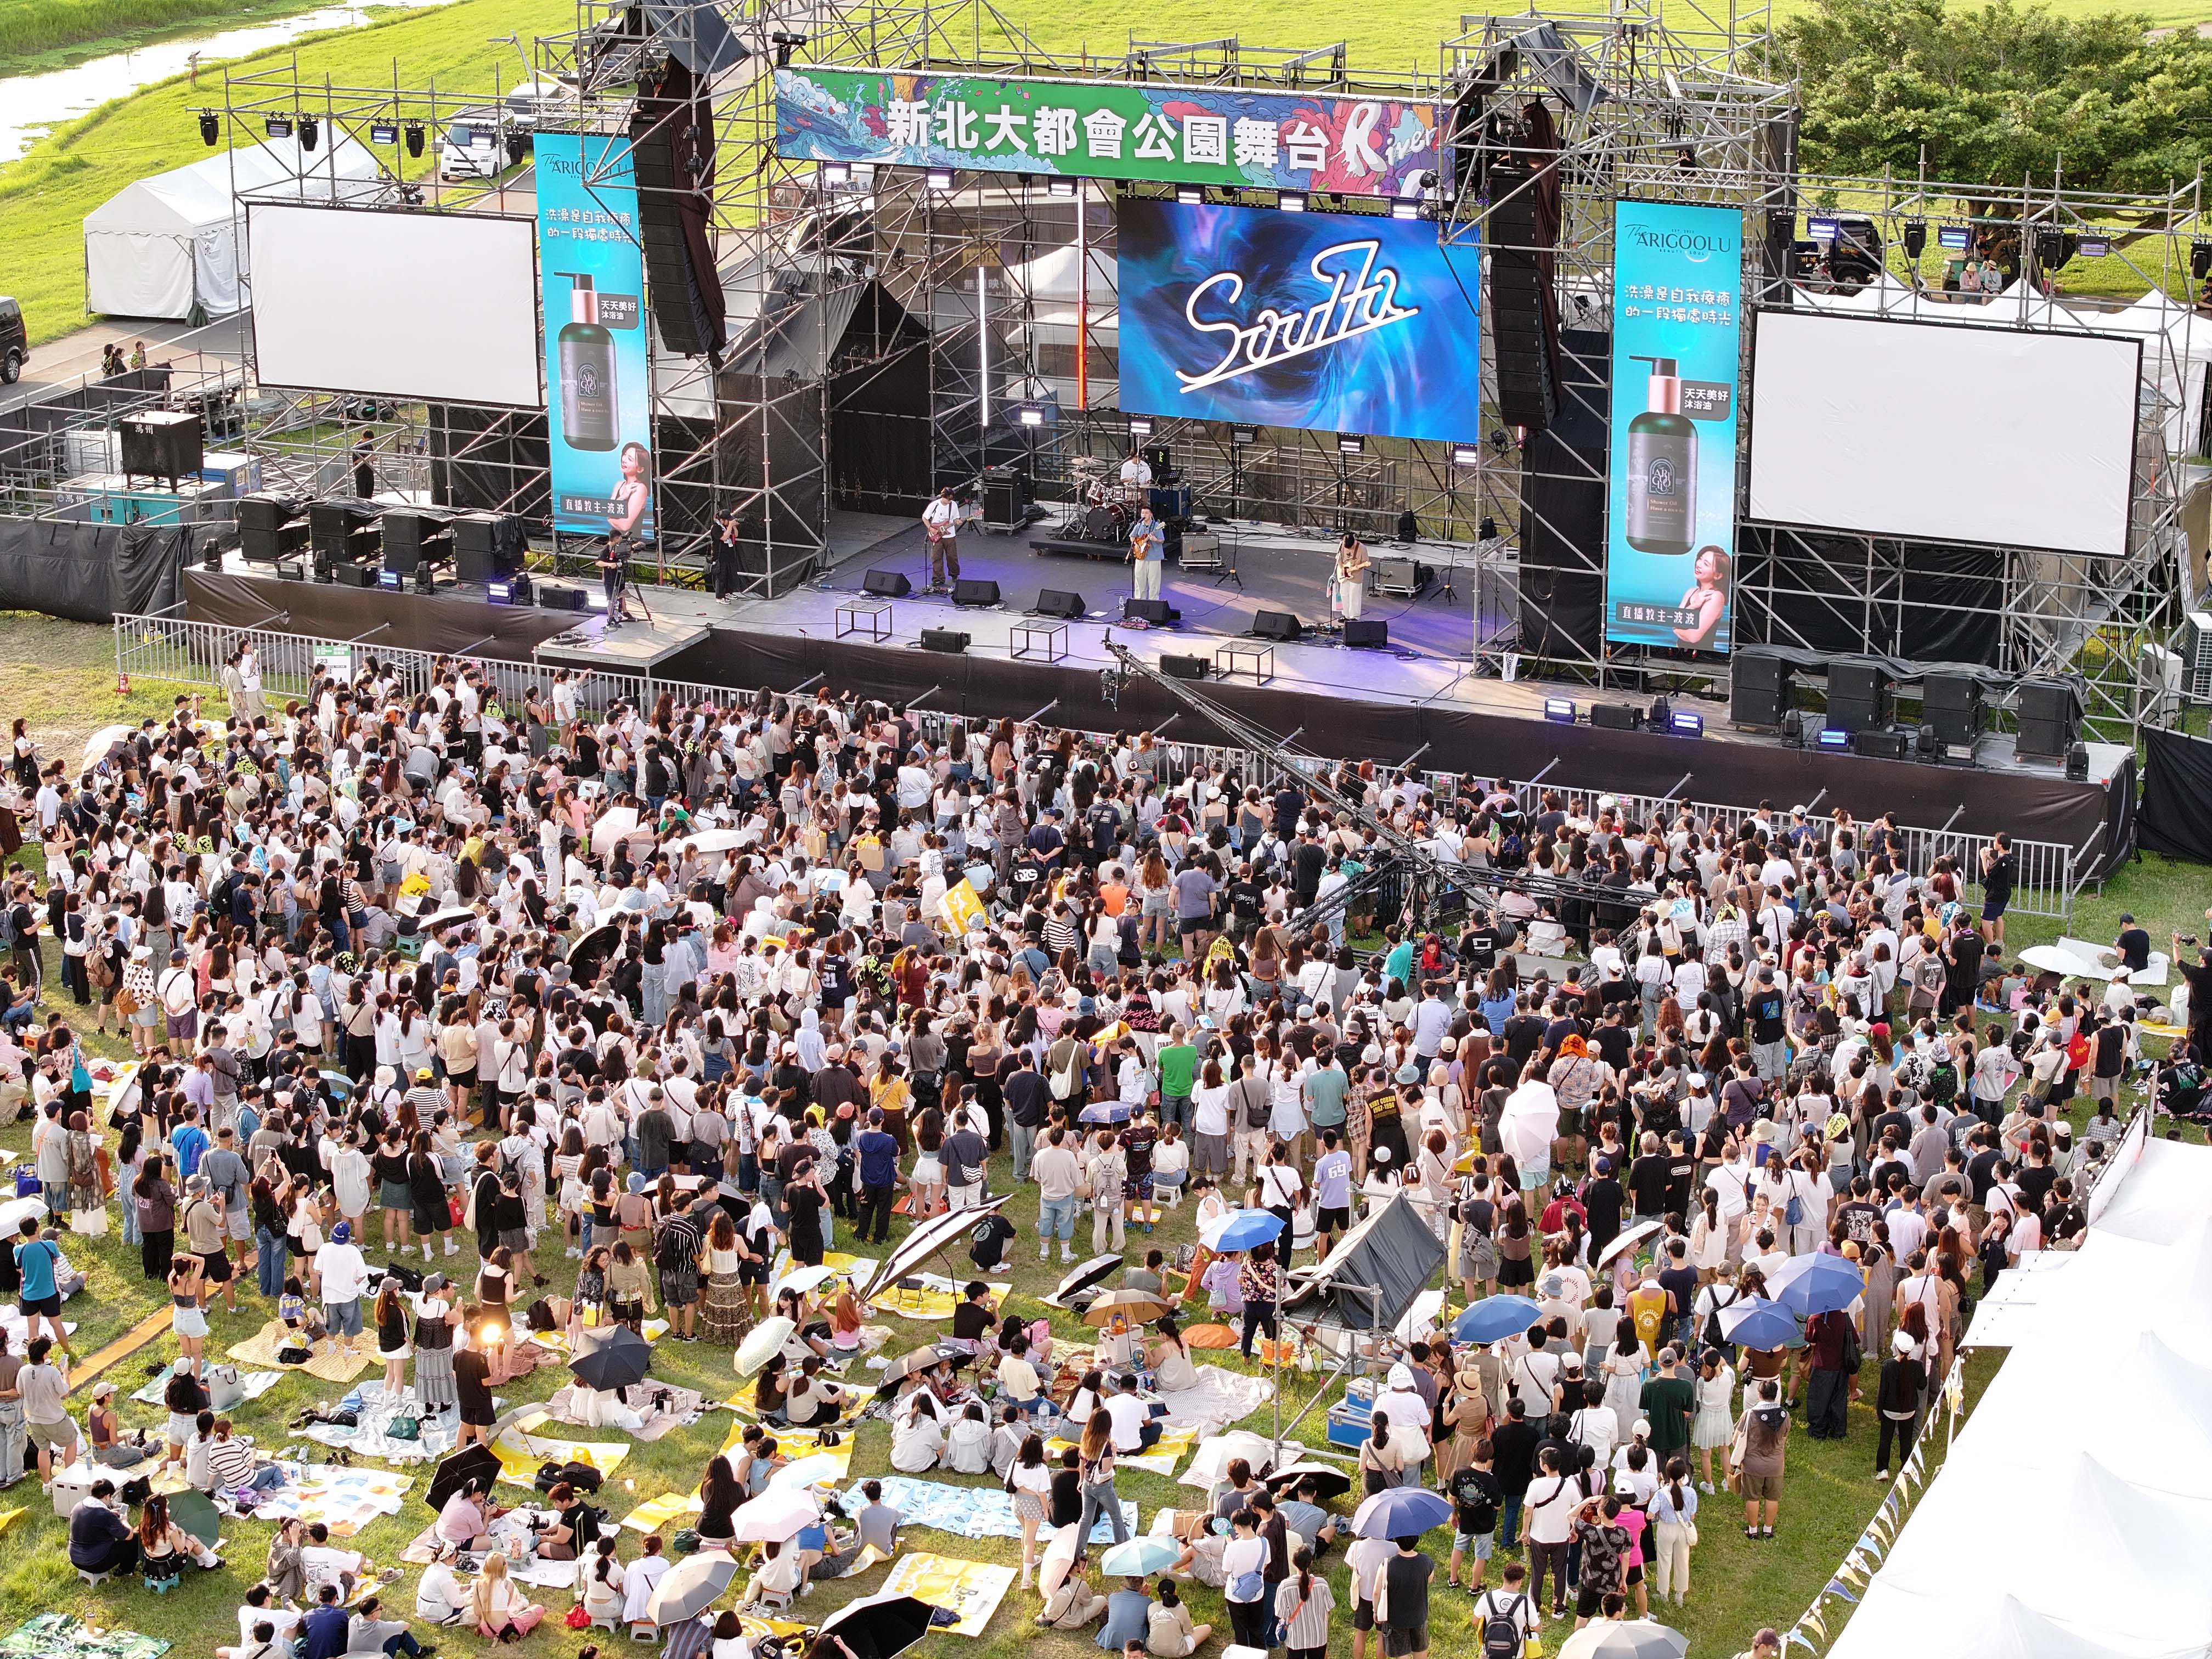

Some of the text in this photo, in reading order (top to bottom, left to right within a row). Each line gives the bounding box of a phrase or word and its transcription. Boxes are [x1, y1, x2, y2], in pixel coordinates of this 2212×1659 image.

[887, 98, 1331, 171] 新北大都會公園舞台
[545, 208, 631, 225] 洗澡是自我療癒
[547, 227, 634, 244] 的一段獨處時光
[1636, 233, 1730, 252] ARIGOOLU
[1624, 285, 1730, 306] 洗澡是自我療癒
[601, 300, 636, 312] 天天美好
[601, 310, 624, 320] 沐浴油
[1626, 306, 1732, 326] 的一段獨處時光
[1684, 388, 1729, 402] 天天美好
[1684, 399, 1712, 411] 沐浴油
[1622, 606, 1695, 625] 直播教主-波波
[821, 972, 838, 988] 21
[1373, 1102, 1395, 1113] 1967-1994
